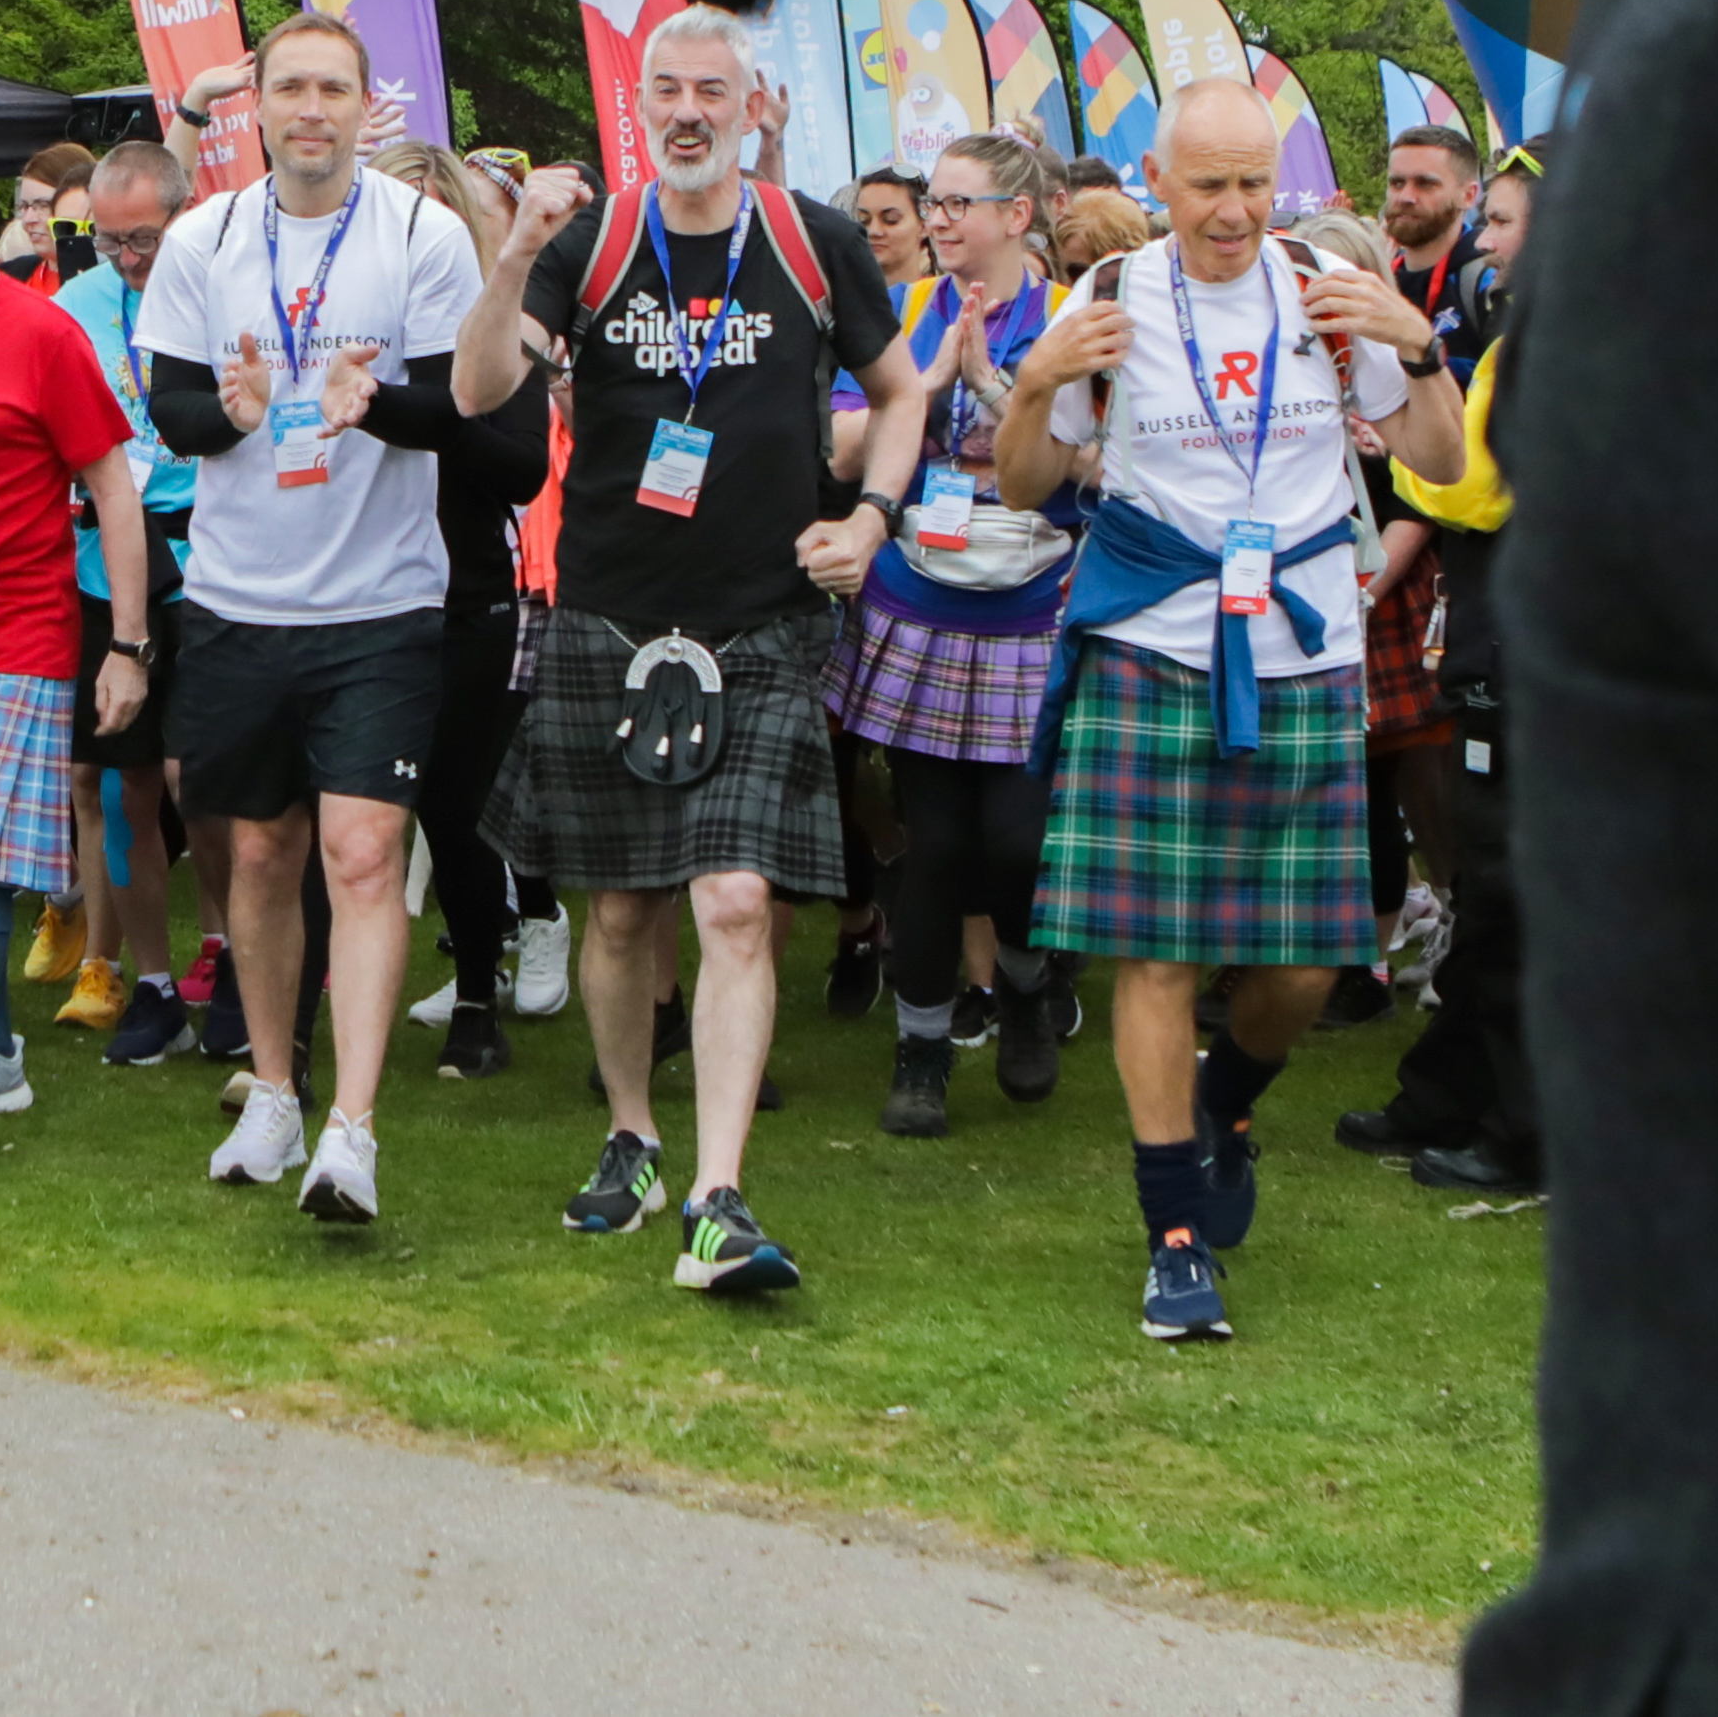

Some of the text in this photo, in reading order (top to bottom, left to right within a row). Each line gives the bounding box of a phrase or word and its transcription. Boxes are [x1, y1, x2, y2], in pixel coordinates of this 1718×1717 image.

[224, 339, 287, 355] RUSEL
[1138, 413, 1211, 435] RUSSEL
[1182, 426, 1307, 451] FOUDAION
